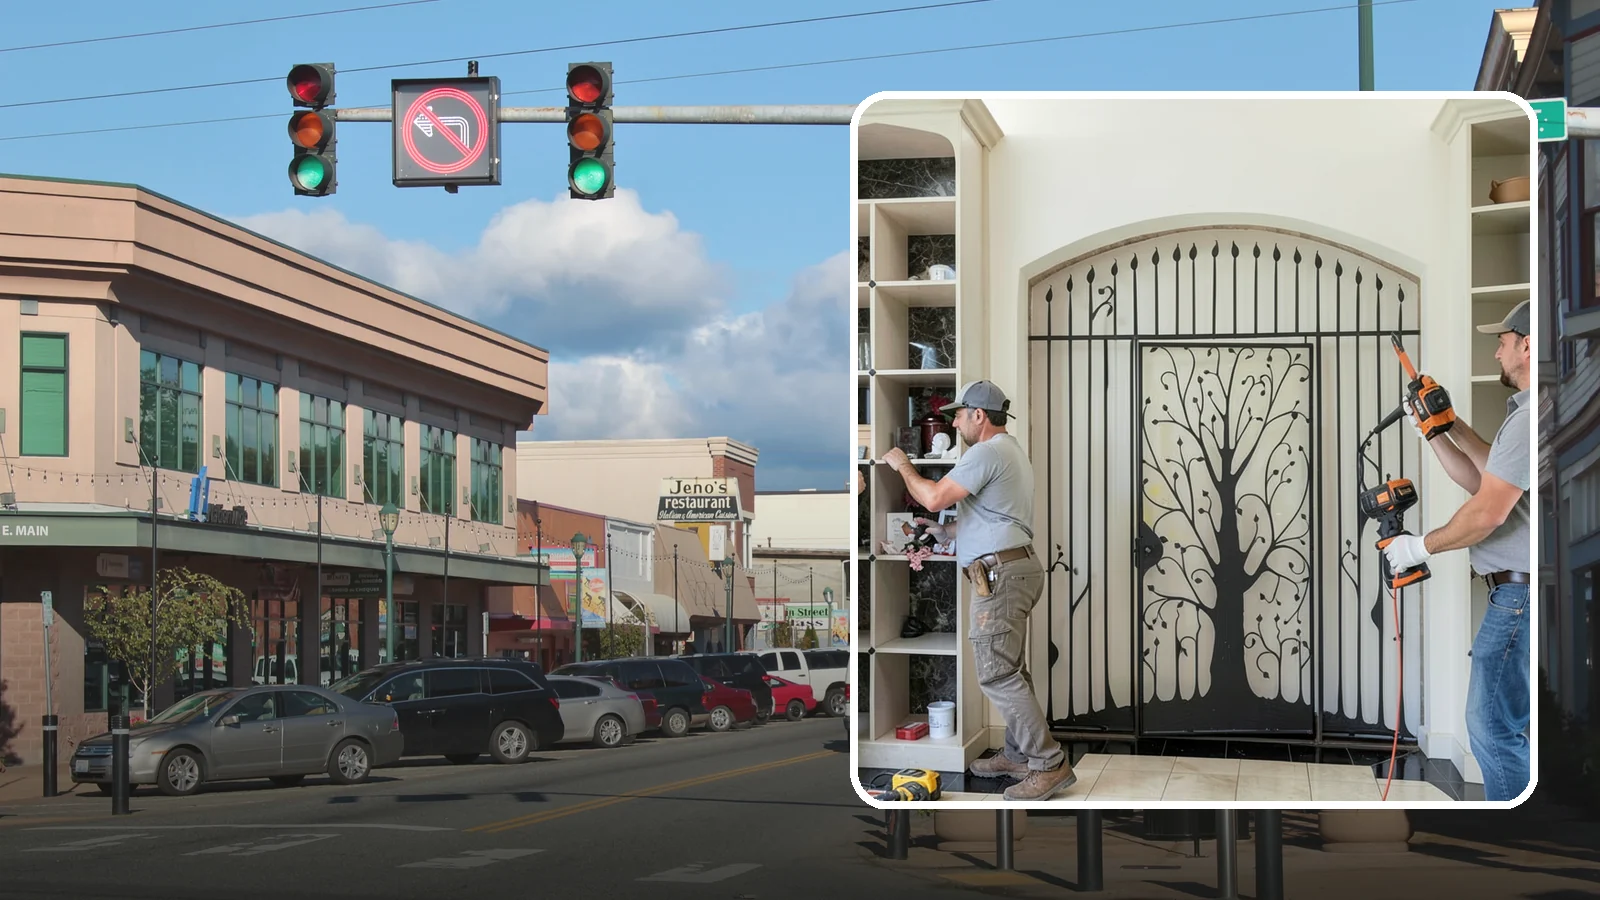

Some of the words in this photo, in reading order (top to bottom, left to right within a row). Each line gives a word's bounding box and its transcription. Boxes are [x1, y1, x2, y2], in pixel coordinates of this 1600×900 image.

[669, 480, 727, 495] Jeno's
[665, 497, 731, 509] restaurant
[659, 510, 681, 520] Italian
[686, 510, 714, 519] American
[715, 509, 737, 519] Cuisine
[2, 525, 13, 536] E.
[15, 525, 49, 536] MAIN
[797, 607, 828, 616] Street
